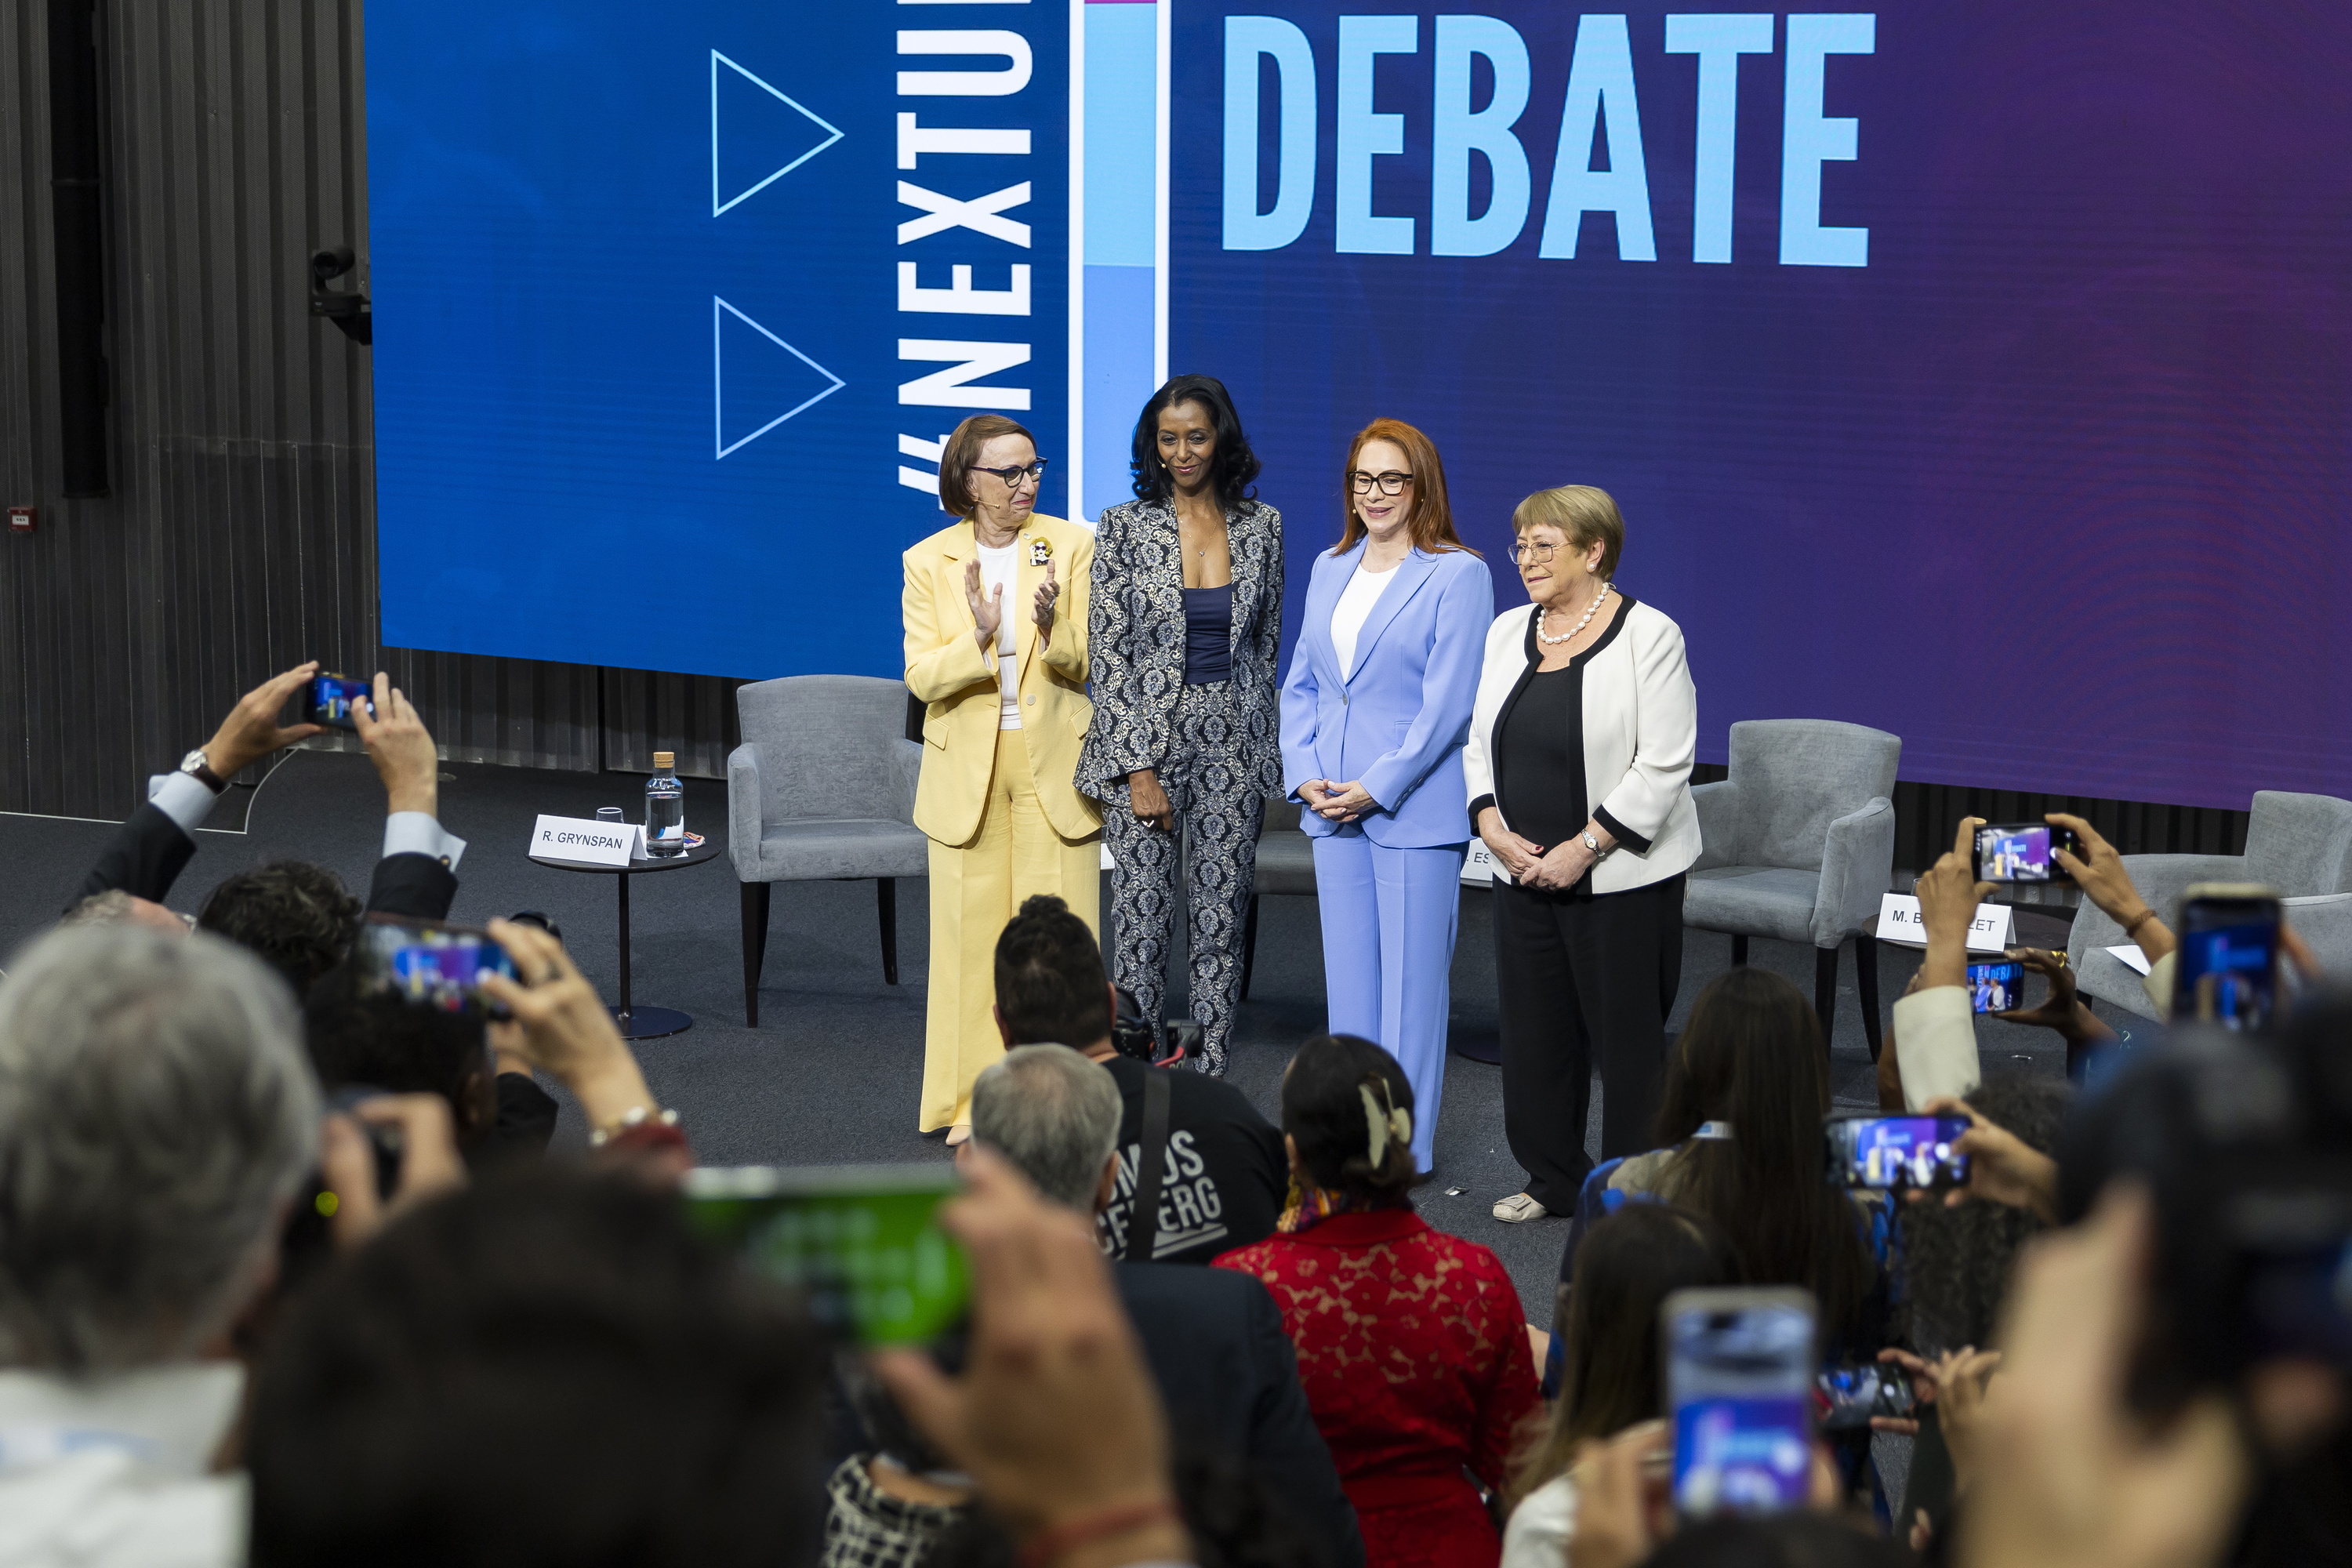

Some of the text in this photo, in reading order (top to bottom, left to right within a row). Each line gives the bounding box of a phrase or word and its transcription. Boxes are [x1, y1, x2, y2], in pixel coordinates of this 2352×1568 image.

[1221, 13, 1877, 267] DEBATE
[896, 0, 1033, 511] NEXTU
[542, 830, 623, 849] R. GRYNSPAN
[1892, 909, 1908, 923] M.
